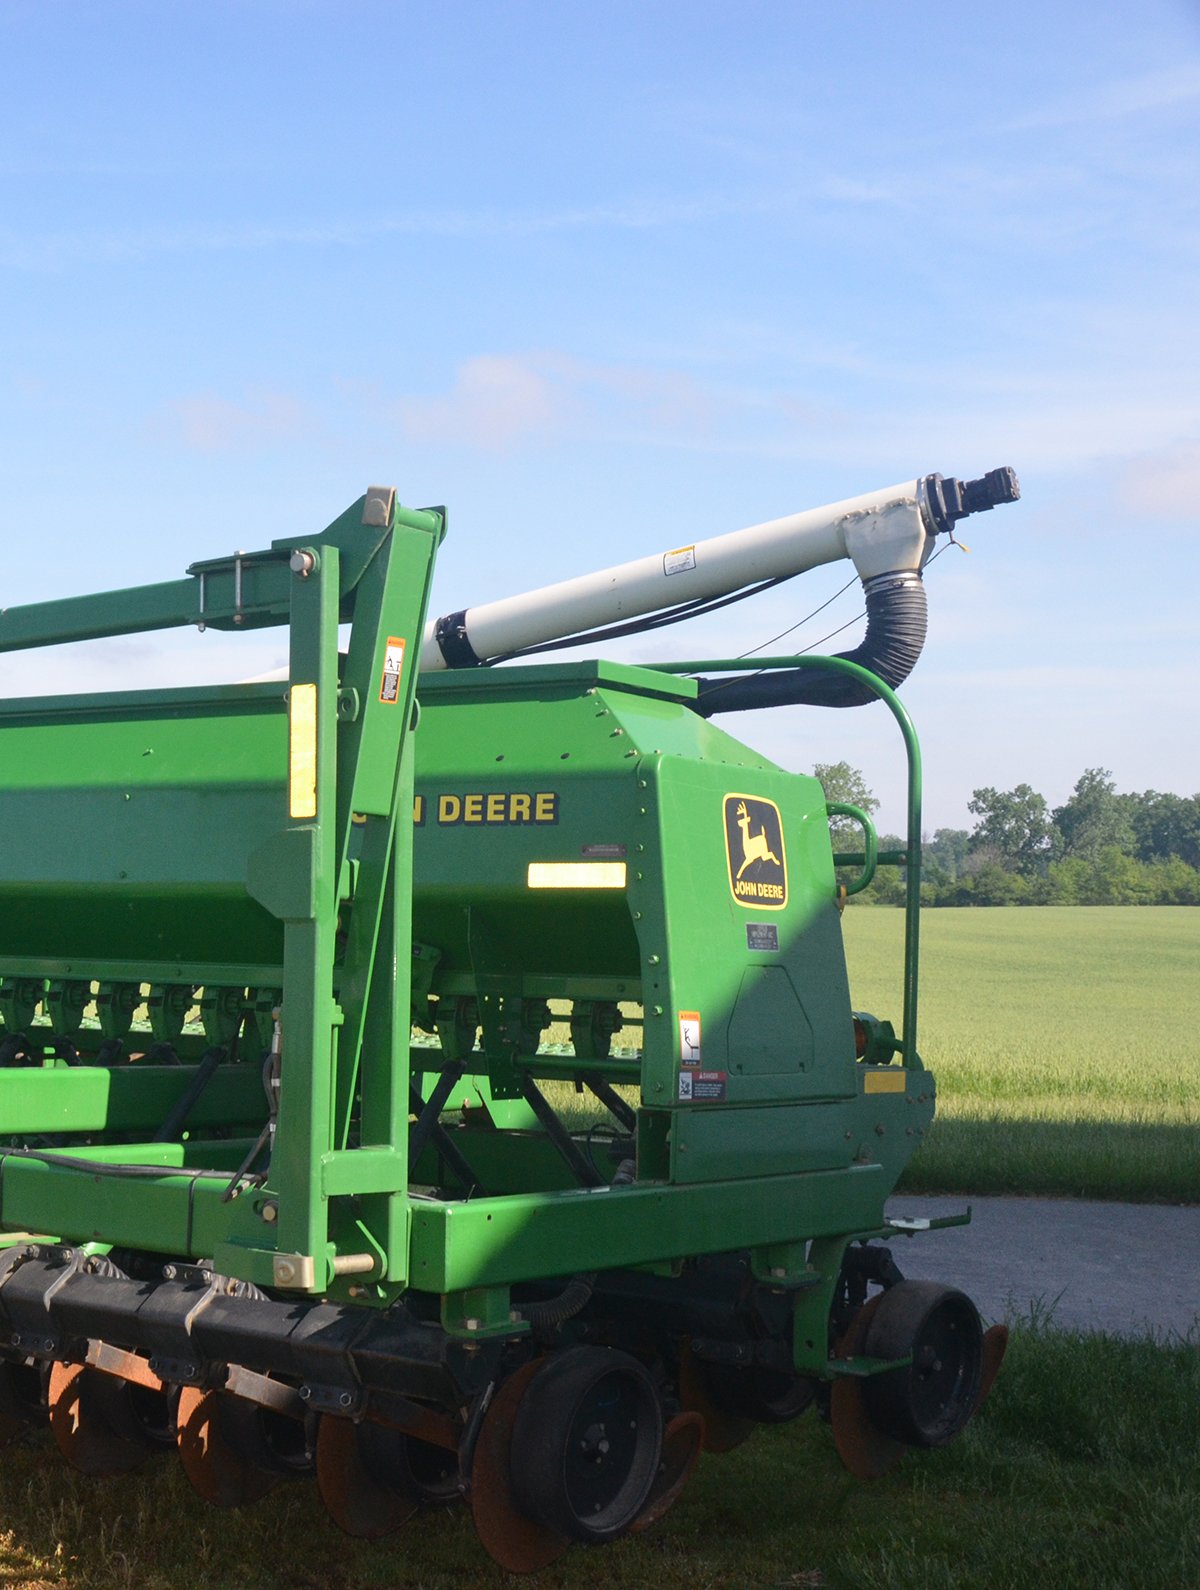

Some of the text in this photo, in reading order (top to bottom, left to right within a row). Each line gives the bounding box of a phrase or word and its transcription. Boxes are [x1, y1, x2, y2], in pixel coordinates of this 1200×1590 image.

[438, 792, 557, 824] DEERE
[735, 881, 784, 899] JOHN DEERE
